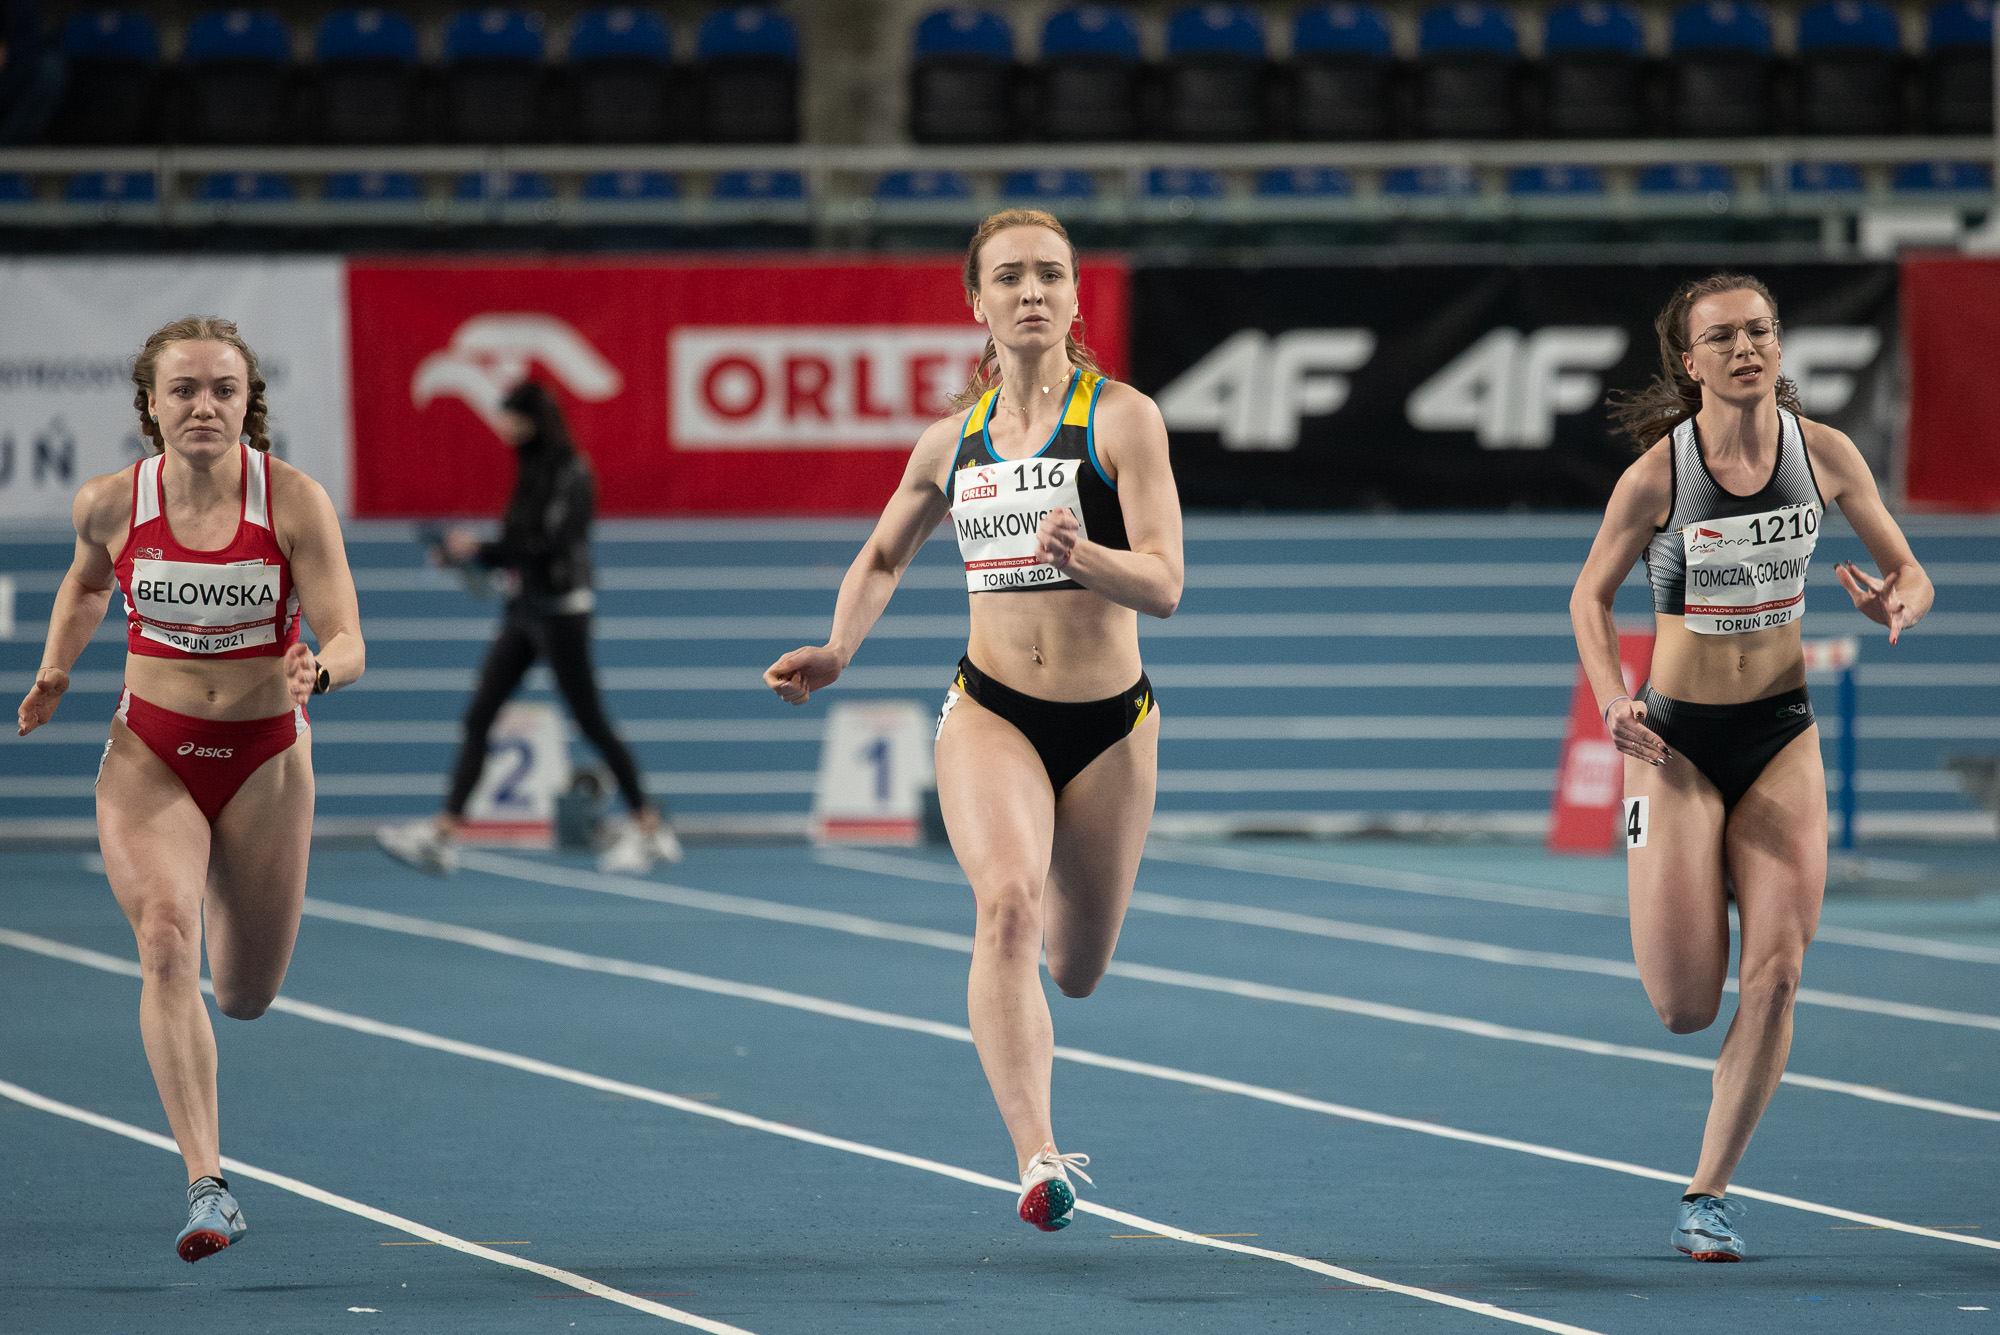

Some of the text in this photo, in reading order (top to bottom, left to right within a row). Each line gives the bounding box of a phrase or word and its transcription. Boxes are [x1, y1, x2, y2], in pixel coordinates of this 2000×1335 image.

[1780, 325, 1883, 416] F
[1152, 327, 1379, 451] 4F
[1404, 325, 1631, 450] 4F
[963, 485, 996, 501] ORLEN
[1013, 462, 1065, 493] 116
[958, 507, 1082, 541] MAŁKOW
[1749, 508, 1818, 547] 1210
[1690, 537, 1750, 553] arena
[138, 579, 274, 607] BELOWSKA
[983, 567, 1025, 587] TORUŃ
[1715, 609, 1793, 632] TORUŃ 2021
[165, 632, 246, 651] TORUŃ 2021
[194, 746, 234, 758] asics
[486, 733, 536, 808] 2
[858, 736, 892, 802] 1
[1627, 800, 1642, 844] 4
